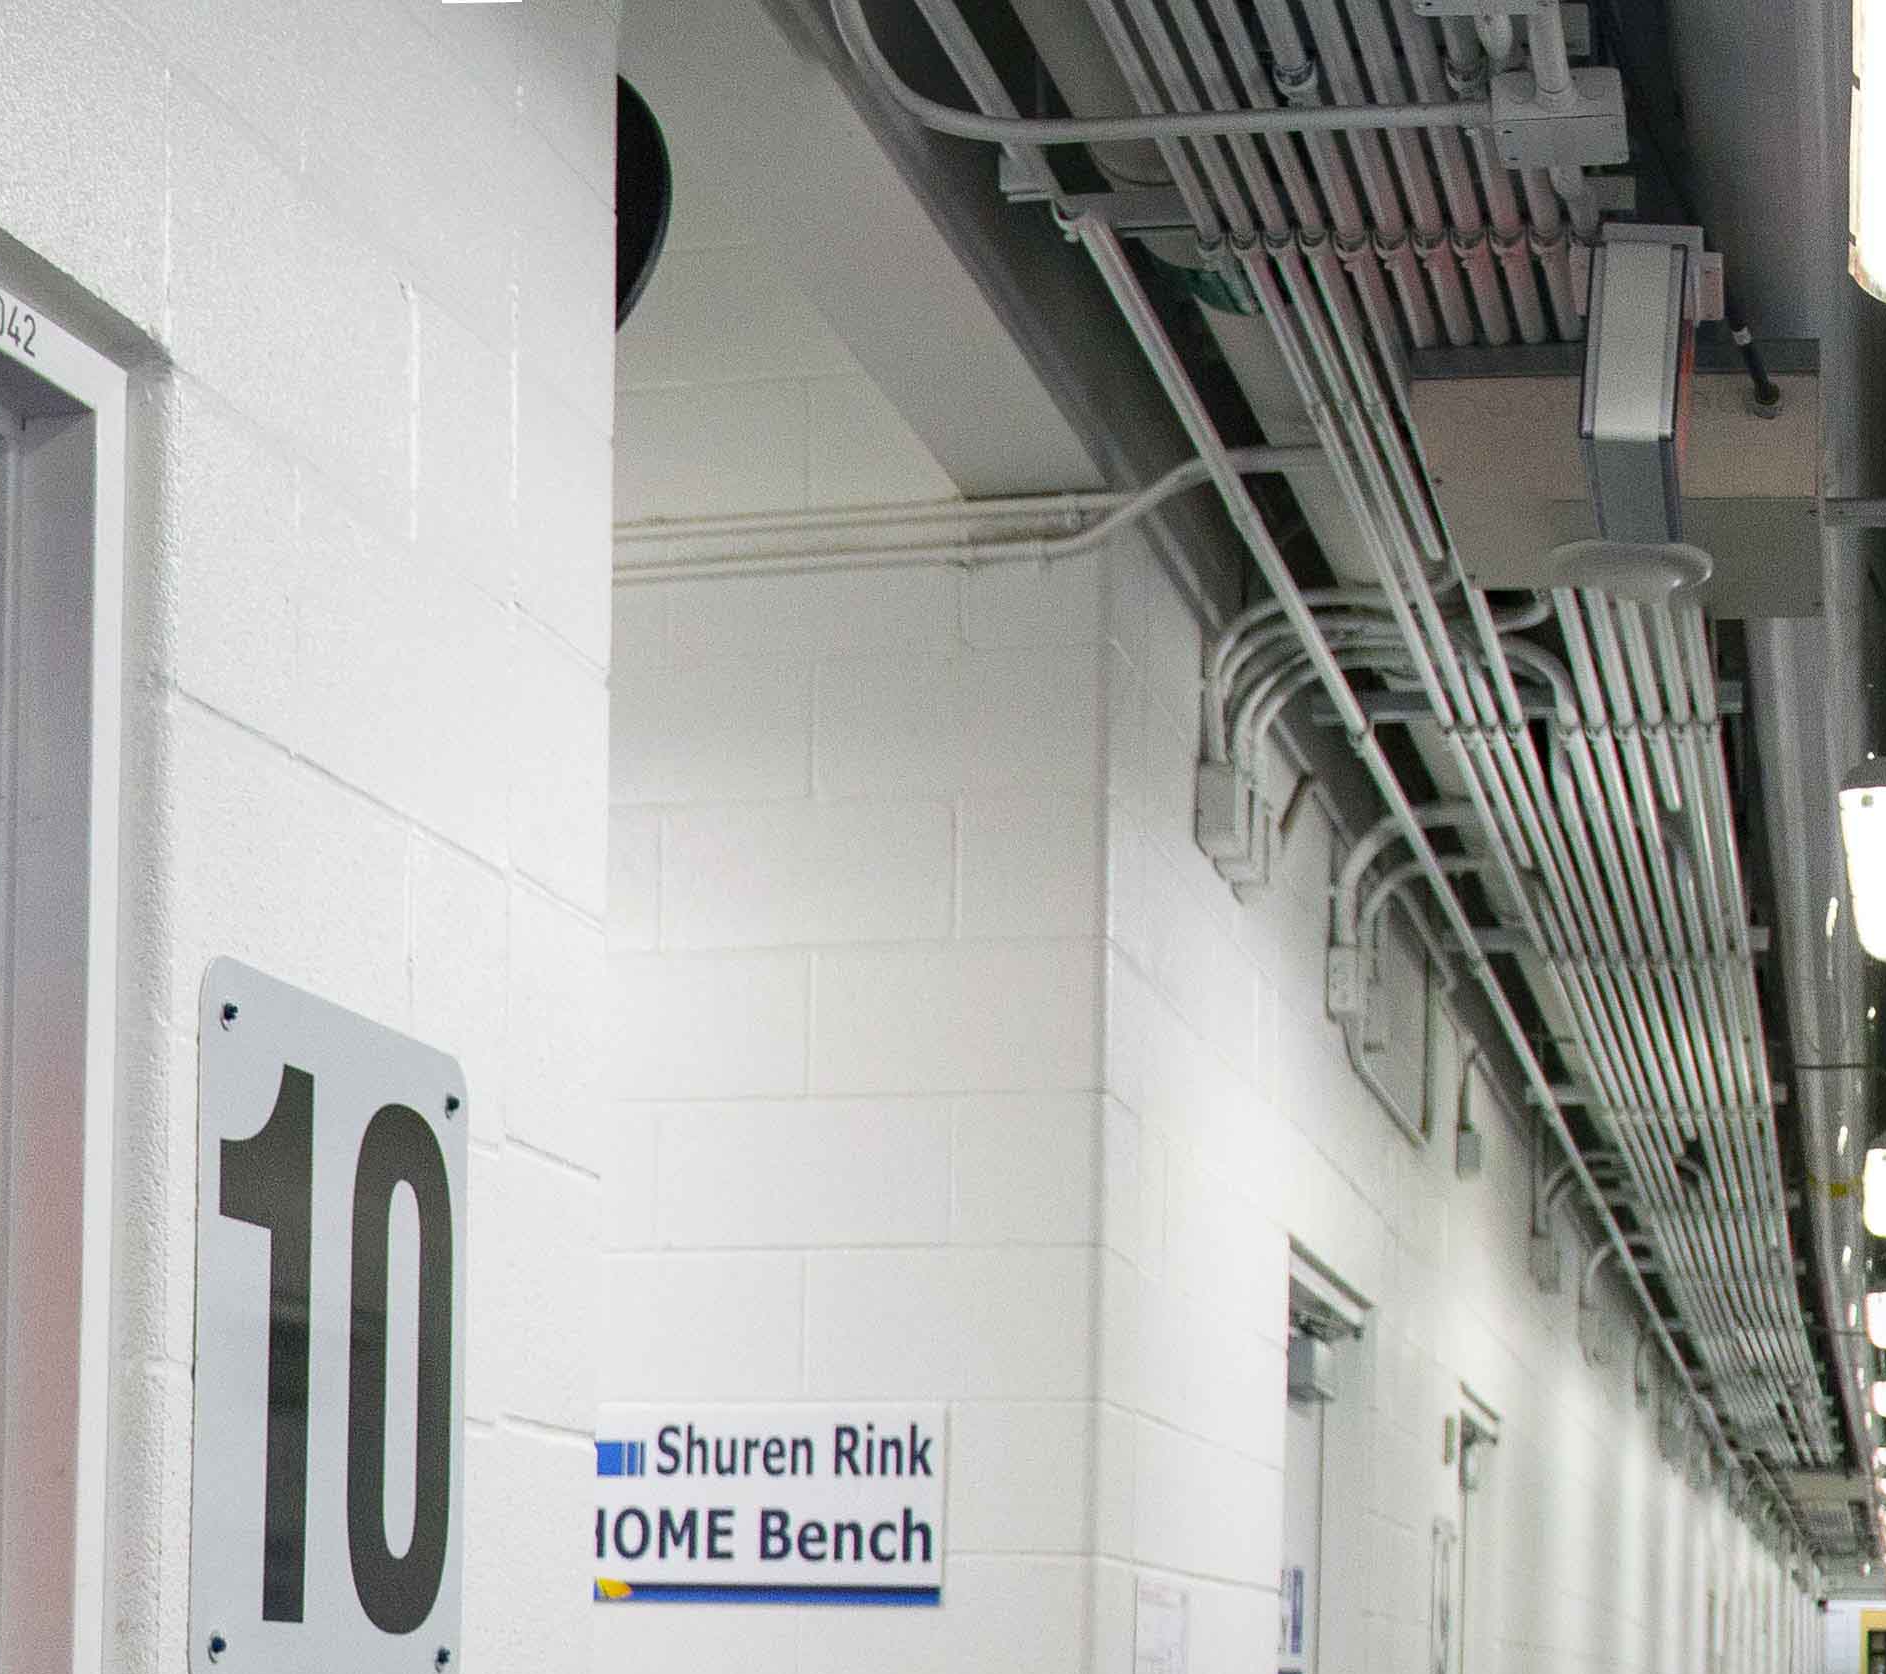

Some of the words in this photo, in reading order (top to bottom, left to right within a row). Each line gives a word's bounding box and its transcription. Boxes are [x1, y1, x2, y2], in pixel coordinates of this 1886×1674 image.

[218, 1063, 453, 1635] 10
[655, 1421, 815, 1478] Shuren
[832, 1422, 933, 1478] Rink
[757, 1507, 933, 1563] Bench
